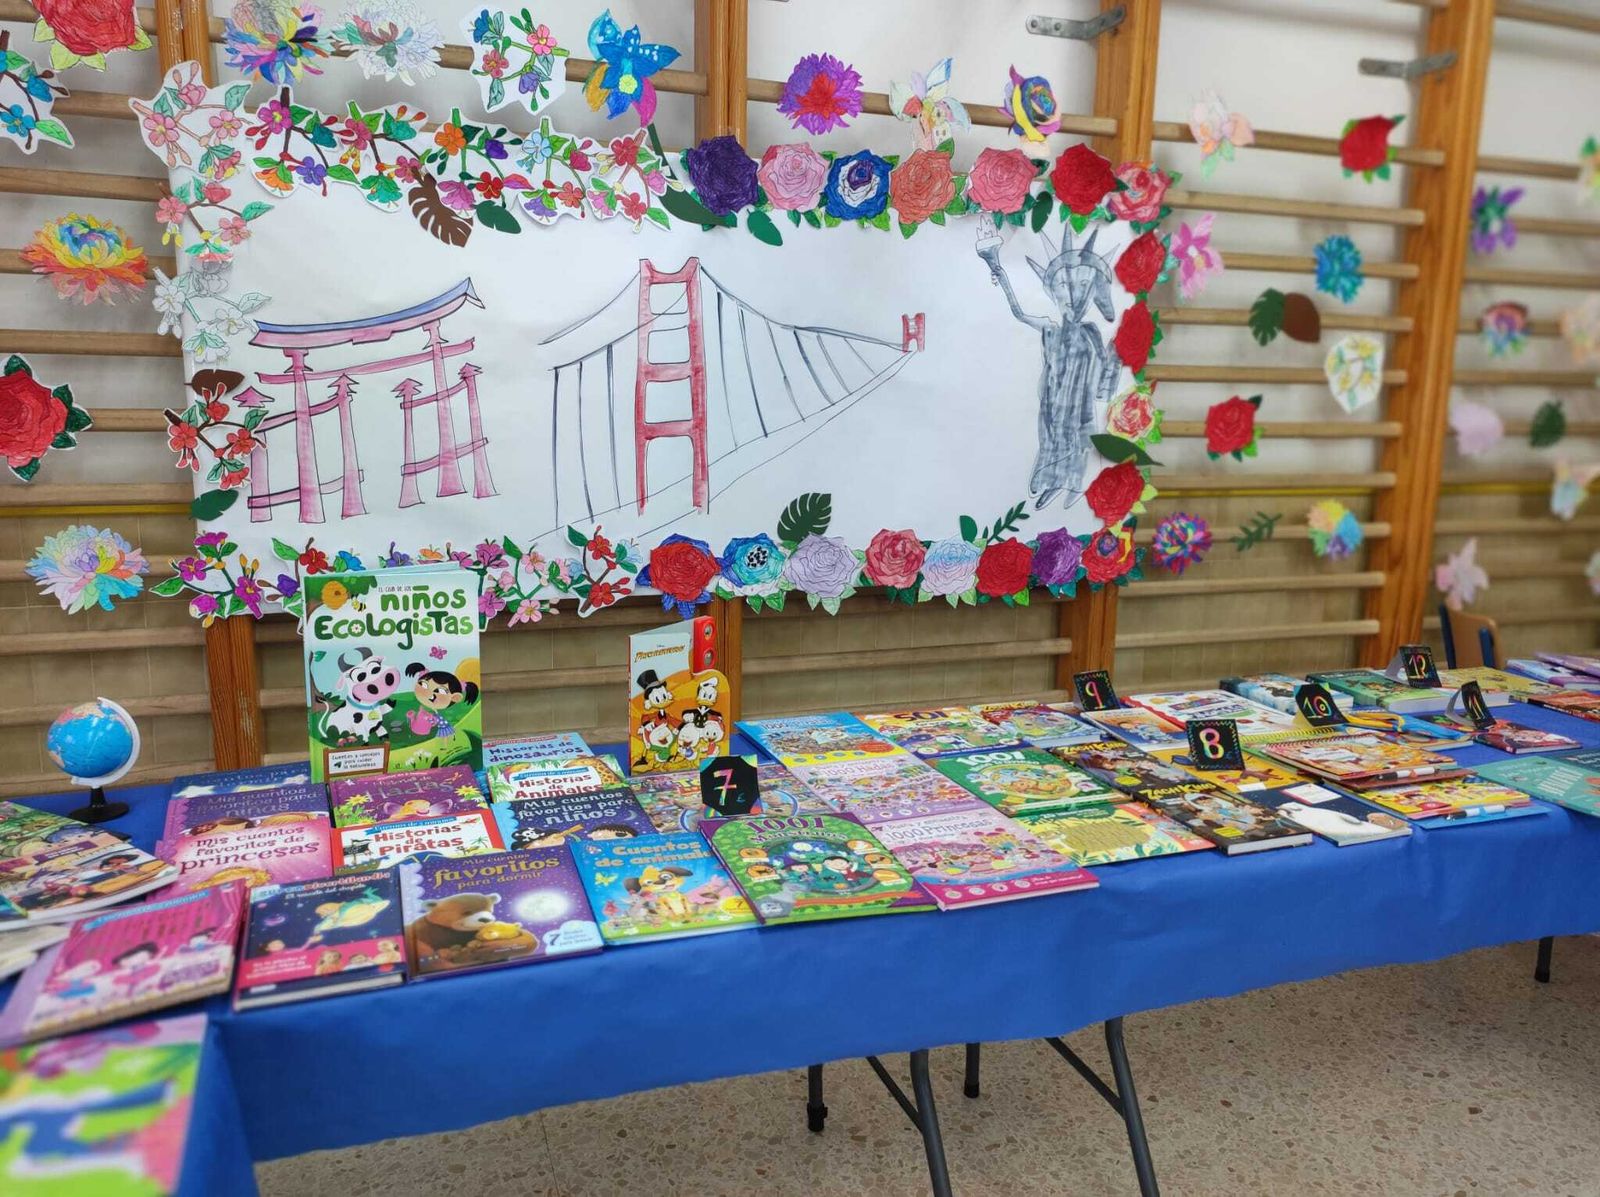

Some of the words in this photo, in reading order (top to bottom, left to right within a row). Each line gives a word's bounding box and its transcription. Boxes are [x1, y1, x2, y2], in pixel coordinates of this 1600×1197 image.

[380, 585, 467, 612] niños
[1085, 680, 1105, 710] 9
[1303, 695, 1332, 719] 10
[558, 741, 574, 749] de
[1199, 727, 1225, 760] 8
[489, 746, 585, 763] dinosaurios
[956, 751, 1026, 767] 1001
[519, 774, 592, 788] Historias
[713, 768, 737, 806] 7
[514, 783, 605, 799] Animales
[523, 800, 556, 809] Mis
[560, 791, 624, 804] cuentos
[518, 802, 592, 820] favoritos
[597, 798, 634, 810] para
[545, 808, 617, 825] niños
[236, 826, 305, 841] cuentos
[374, 823, 462, 842] Historias
[746, 816, 824, 833] 1001
[885, 827, 923, 841] 1000
[922, 819, 993, 835] Princesas
[196, 840, 276, 856] favoritos
[283, 835, 305, 844] de
[379, 837, 464, 856] Piratas
[406, 837, 423, 845] de
[612, 841, 702, 856] Cuentos
[180, 841, 320, 875] princesas
[487, 853, 530, 863] cuentos
[594, 857, 625, 868] de
[433, 857, 560, 889] favoritos
[457, 879, 490, 890] para
[496, 871, 543, 883] dormir
[550, 934, 561, 946] 7
